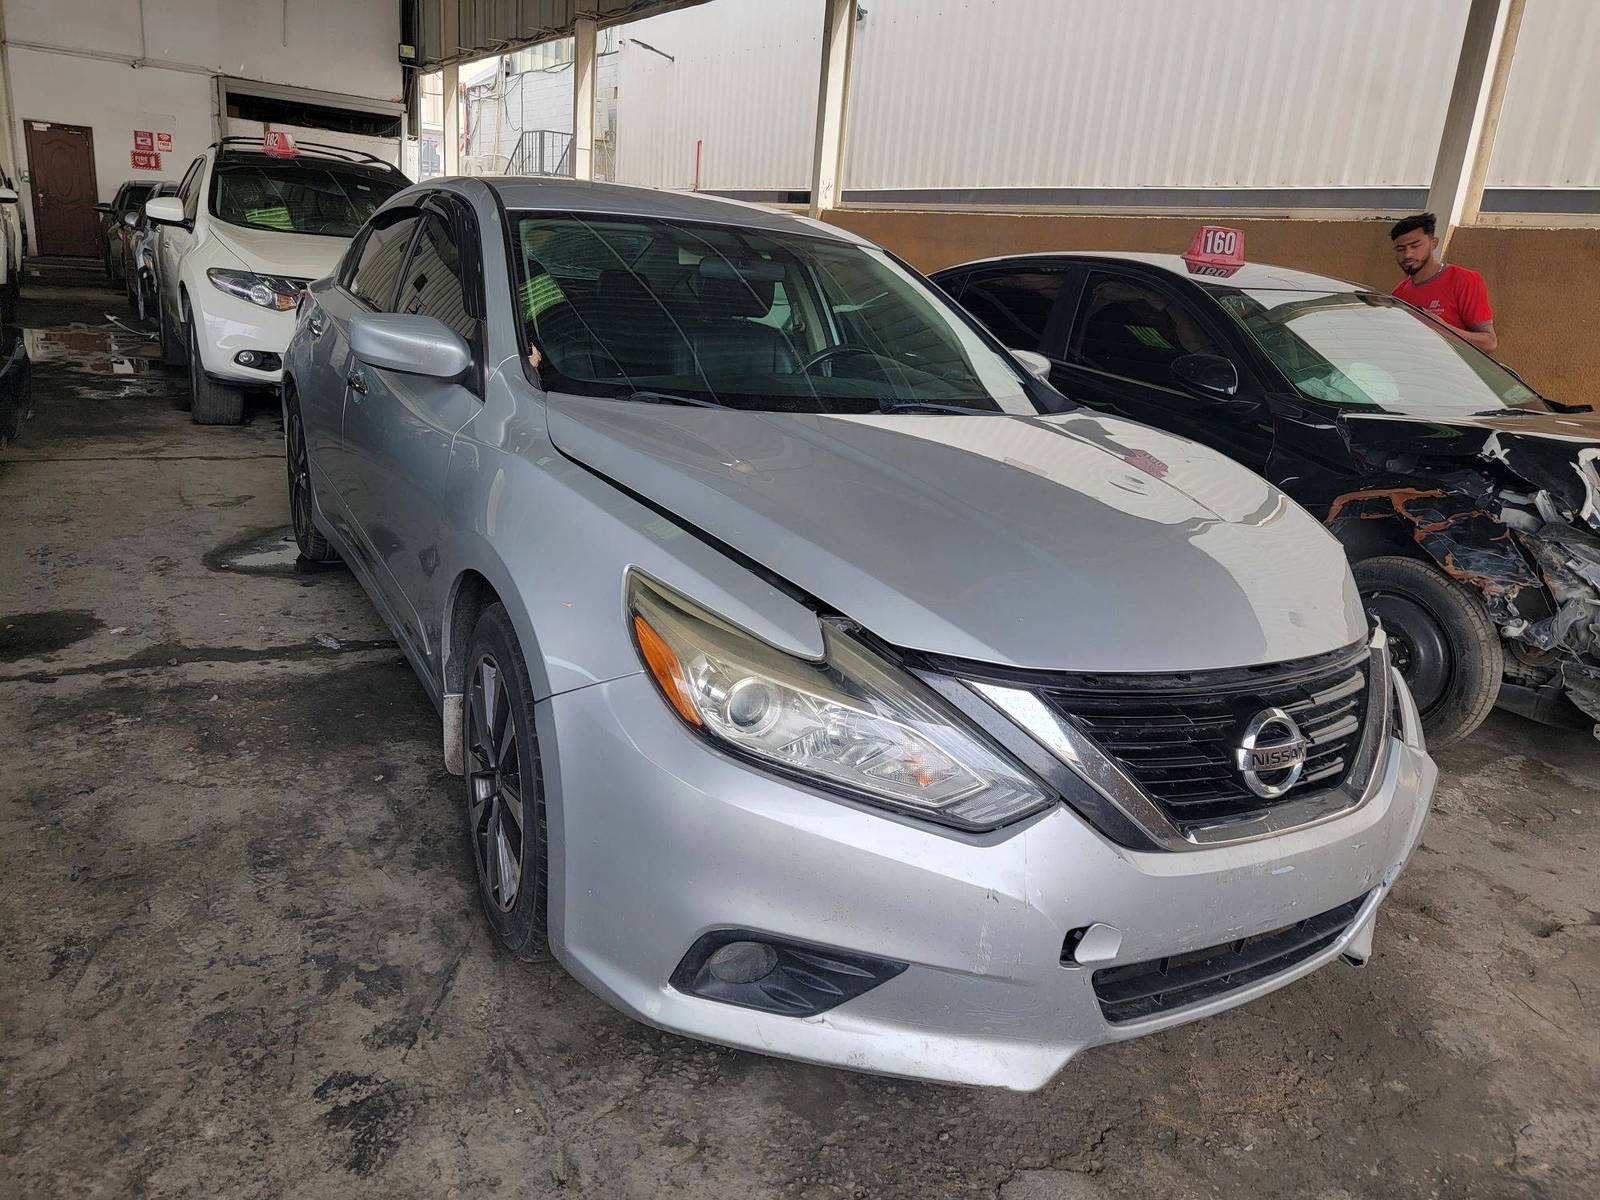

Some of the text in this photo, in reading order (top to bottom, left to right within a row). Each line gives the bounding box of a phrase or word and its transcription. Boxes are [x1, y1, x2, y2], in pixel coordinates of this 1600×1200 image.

[266, 133, 279, 146] 182
[1206, 231, 1236, 254] 160
[1252, 744, 1304, 766] NISSAN
